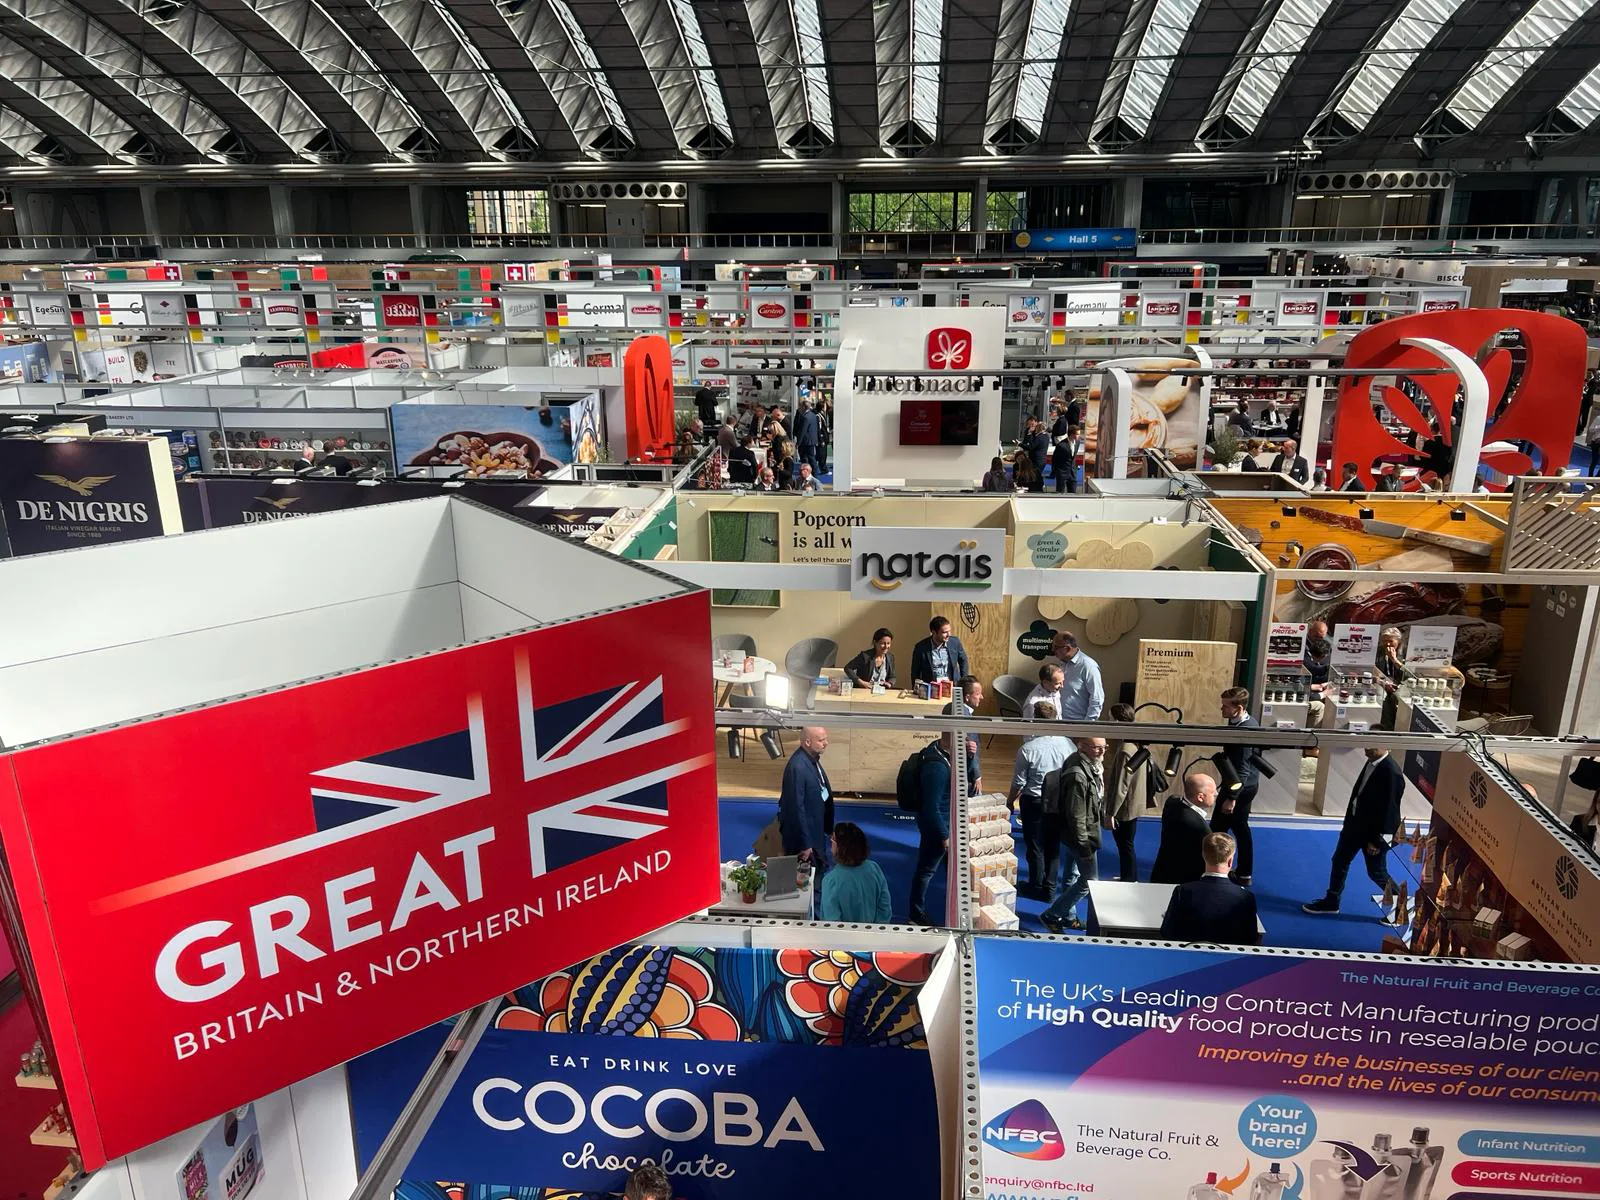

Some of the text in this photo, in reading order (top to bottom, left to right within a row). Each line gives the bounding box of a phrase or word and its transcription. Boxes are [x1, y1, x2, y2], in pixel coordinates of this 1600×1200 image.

[1069, 235, 1098, 243] Hall 5
[1067, 301, 1107, 315] Germany
[108, 356, 126, 365] BUILD
[16, 500, 149, 523] DE NIGRIS
[793, 510, 866, 530] Popcorn
[793, 532, 807, 548] is
[814, 531, 835, 548] all
[1146, 647, 1194, 658] Premium
[1451, 794, 1473, 819] ARTISAN
[1475, 819, 1499, 848] BISCUITS
[1456, 811, 1470, 828] BAKED
[154, 826, 496, 1004] GREAT
[1531, 879, 1560, 911] ARTISAN
[1562, 910, 1592, 947] BISCUITS
[1538, 899, 1555, 919] BAKED
[173, 849, 671, 1061] BRITAIN & NORTHERN IRELAND
[1340, 972, 1368, 984] The
[1372, 974, 1429, 988] Natural
[1433, 977, 1469, 990] Fruit
[1472, 980, 1503, 992] and
[1506, 981, 1580, 998] Beverage
[1010, 978, 1055, 999] The
[1062, 982, 1114, 1003] UK's
[1120, 987, 1218, 1011] Leading
[1225, 993, 1333, 1017] Contract
[1340, 1000, 1531, 1033] Manufacturing
[997, 1002, 1022, 1019] of
[1026, 1003, 1084, 1026] High
[1091, 1007, 1183, 1033] Quality
[1188, 1013, 1243, 1035] food
[1250, 1019, 1363, 1043] products
[1369, 1025, 1391, 1044] in
[1399, 1030, 1529, 1052] resealable
[549, 1055, 738, 1077] EAT DRINK LOVE
[1197, 1043, 1309, 1069] Improving
[1313, 1052, 1350, 1068] the
[1354, 1054, 1474, 1077] businesses
[1478, 1062, 1504, 1078] of
[1504, 1067, 1545, 1080] our
[1282, 1072, 1344, 1088] ...and
[1347, 1074, 1384, 1090] the
[1388, 1076, 1437, 1094] lives
[1440, 1080, 1467, 1096] of
[1467, 1085, 1506, 1098] our
[472, 1077, 826, 1152] COCOBA
[1257, 1103, 1303, 1121] Your
[985, 1126, 1059, 1144] NFBC
[1076, 1124, 1220, 1148] The Natural Fruit &
[1248, 1117, 1308, 1136] brand
[1250, 1132, 1302, 1150] here!
[1477, 1138, 1586, 1154] Infant Nutrition
[1076, 1142, 1172, 1161] Beverage Co.
[1470, 1168, 1583, 1185] Sports Nutrition
